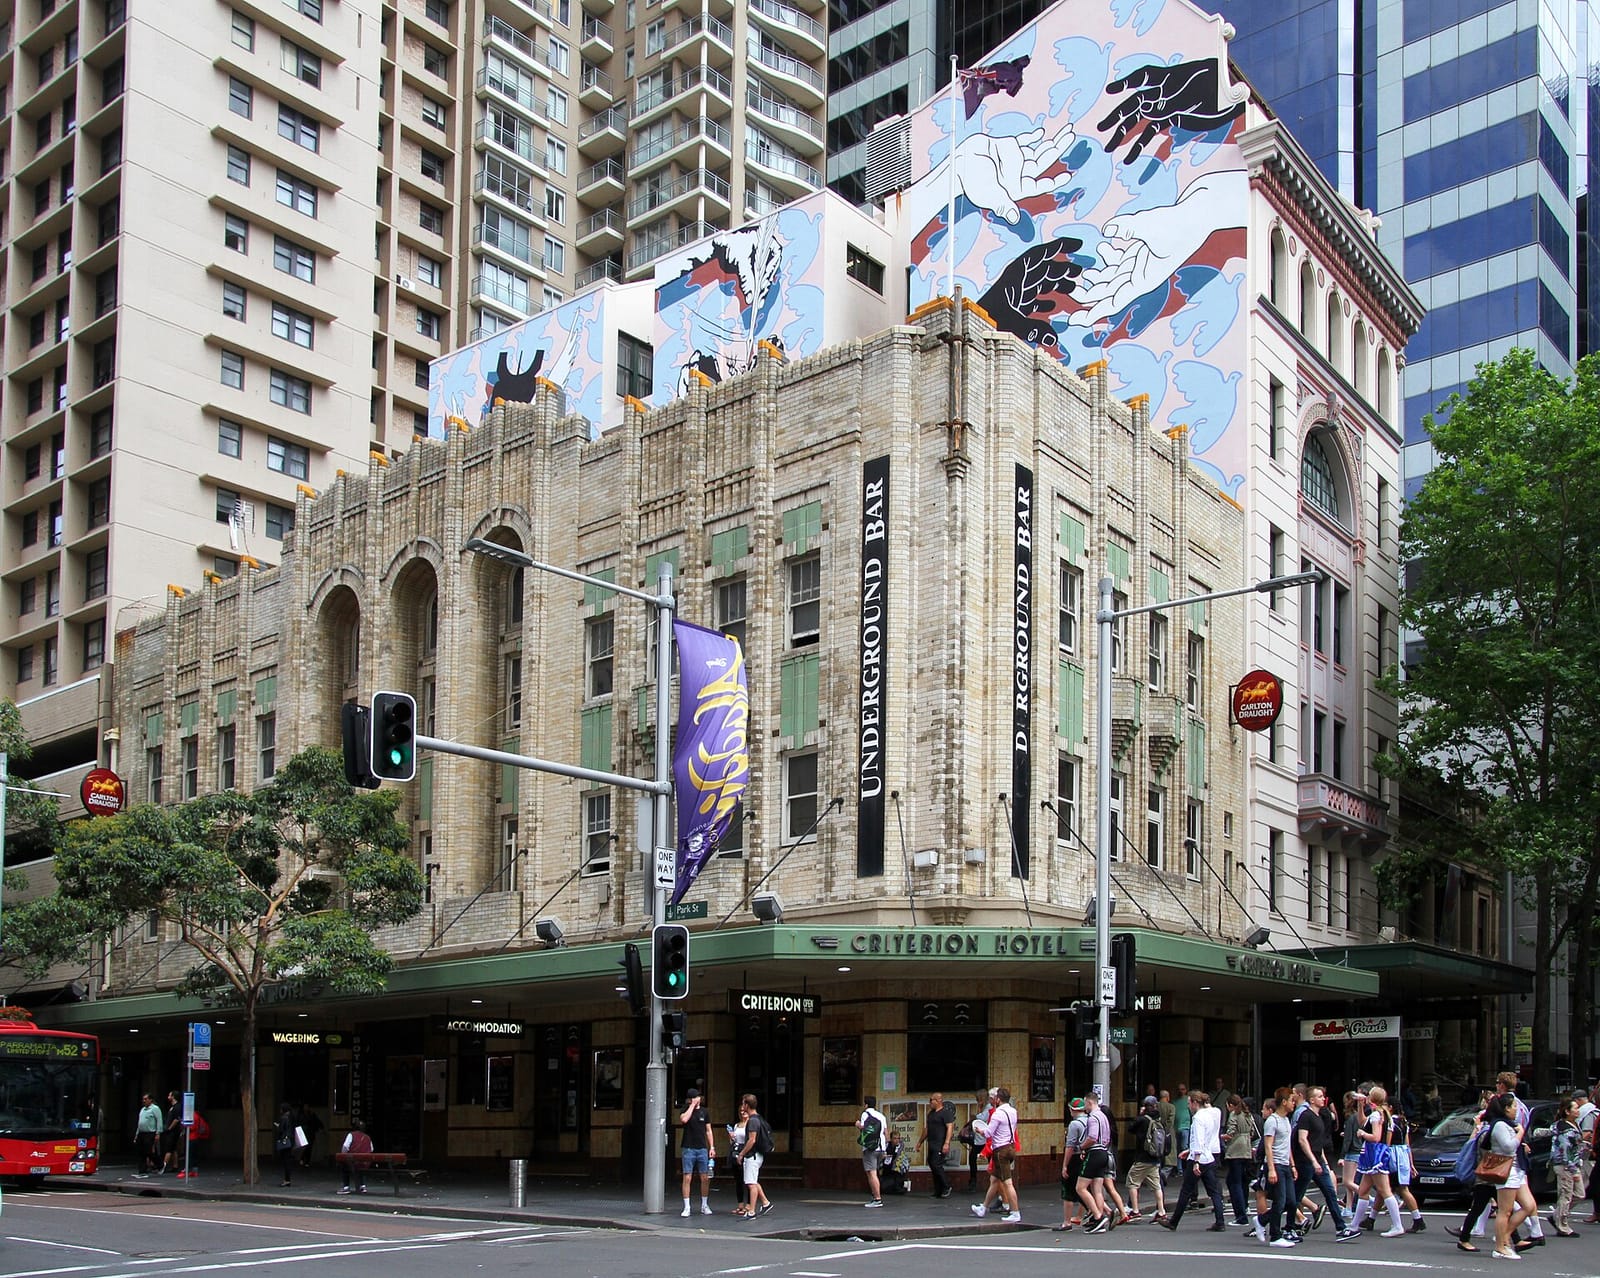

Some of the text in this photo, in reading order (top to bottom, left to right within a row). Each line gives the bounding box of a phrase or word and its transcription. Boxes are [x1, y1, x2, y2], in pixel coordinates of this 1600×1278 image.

[1017, 486, 1032, 552] BAR
[861, 477, 885, 801] UNDERGROUND BAR
[1240, 702, 1273, 710] CARLTON
[1239, 709, 1274, 718] DRAUGHT
[90, 792, 119, 802] CARLTON
[88, 798, 119, 808] DRAUGHT
[658, 851, 673, 862] ONE
[657, 864, 674, 874] WAY
[676, 904, 699, 914] Park St
[852, 934, 1066, 954] CRITERION HOTEL
[1103, 970, 1113, 980] ONE
[1102, 983, 1113, 992] WAY
[741, 994, 801, 1012] CRITERION
[1147, 995, 1161, 1005] OPEN
[447, 1021, 522, 1034] ACCOMMODATION
[1350, 1020, 1388, 1035] Point
[272, 1033, 320, 1044] WAGERING
[56, 1044, 79, 1056] M52
